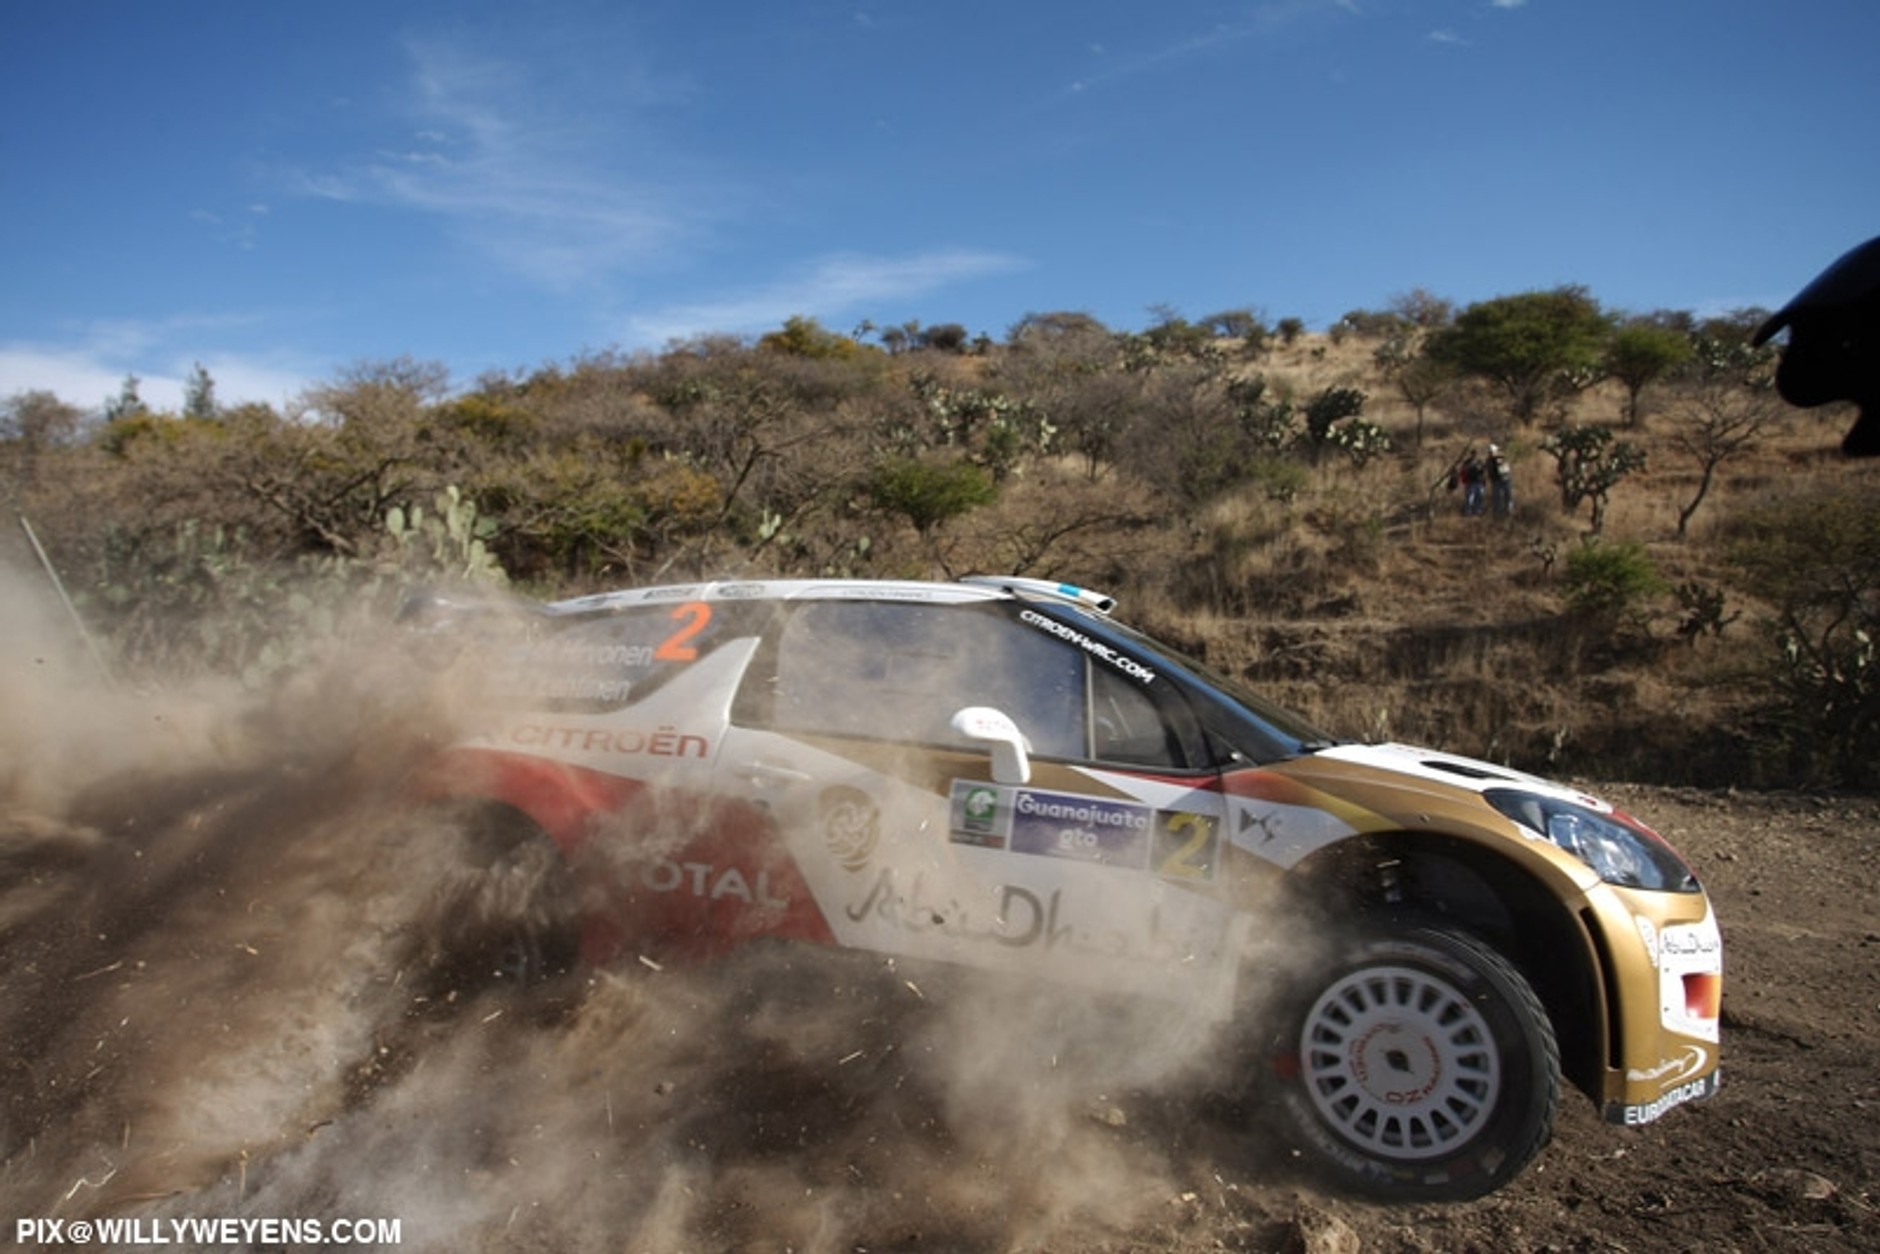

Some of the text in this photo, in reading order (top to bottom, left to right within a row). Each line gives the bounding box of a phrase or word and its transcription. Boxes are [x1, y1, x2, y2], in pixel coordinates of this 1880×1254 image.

[654, 600, 712, 661] 2
[1016, 793, 1148, 829] Guanajuato
[1161, 812, 1211, 879] 2
[618, 854, 791, 909] OTAL
[1000, 884, 1212, 956] Dhab
